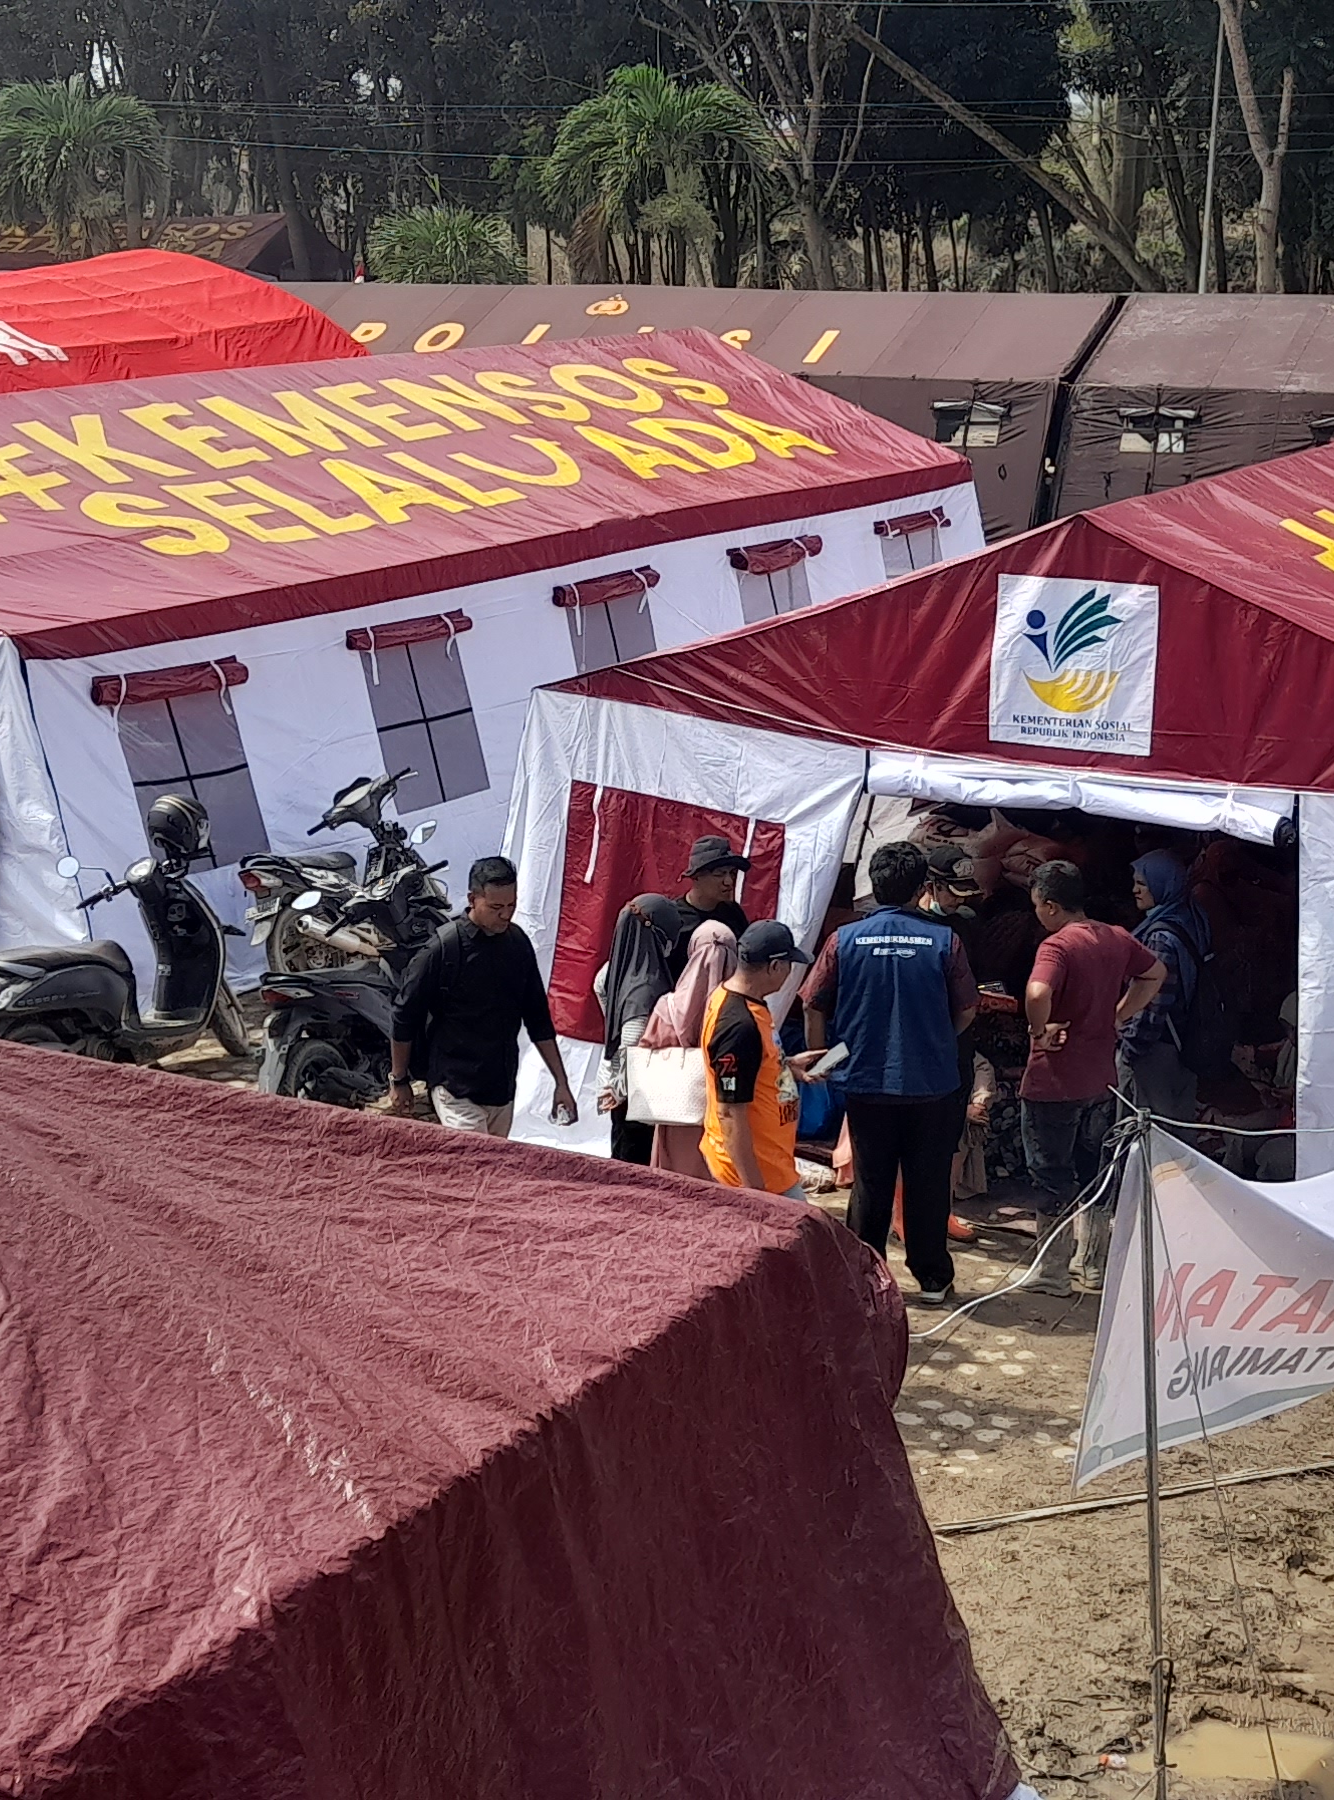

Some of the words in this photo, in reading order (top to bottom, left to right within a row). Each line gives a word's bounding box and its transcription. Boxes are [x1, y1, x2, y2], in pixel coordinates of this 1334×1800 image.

[79, 434, 583, 556] SELALU
[579, 408, 836, 480] ADA
[1012, 713, 1092, 729] KEMENTERIAN
[1095, 719, 1134, 732] SOSIAL
[1020, 726, 1069, 738] REPUBLIK
[1072, 730, 1126, 742] INDONESIA
